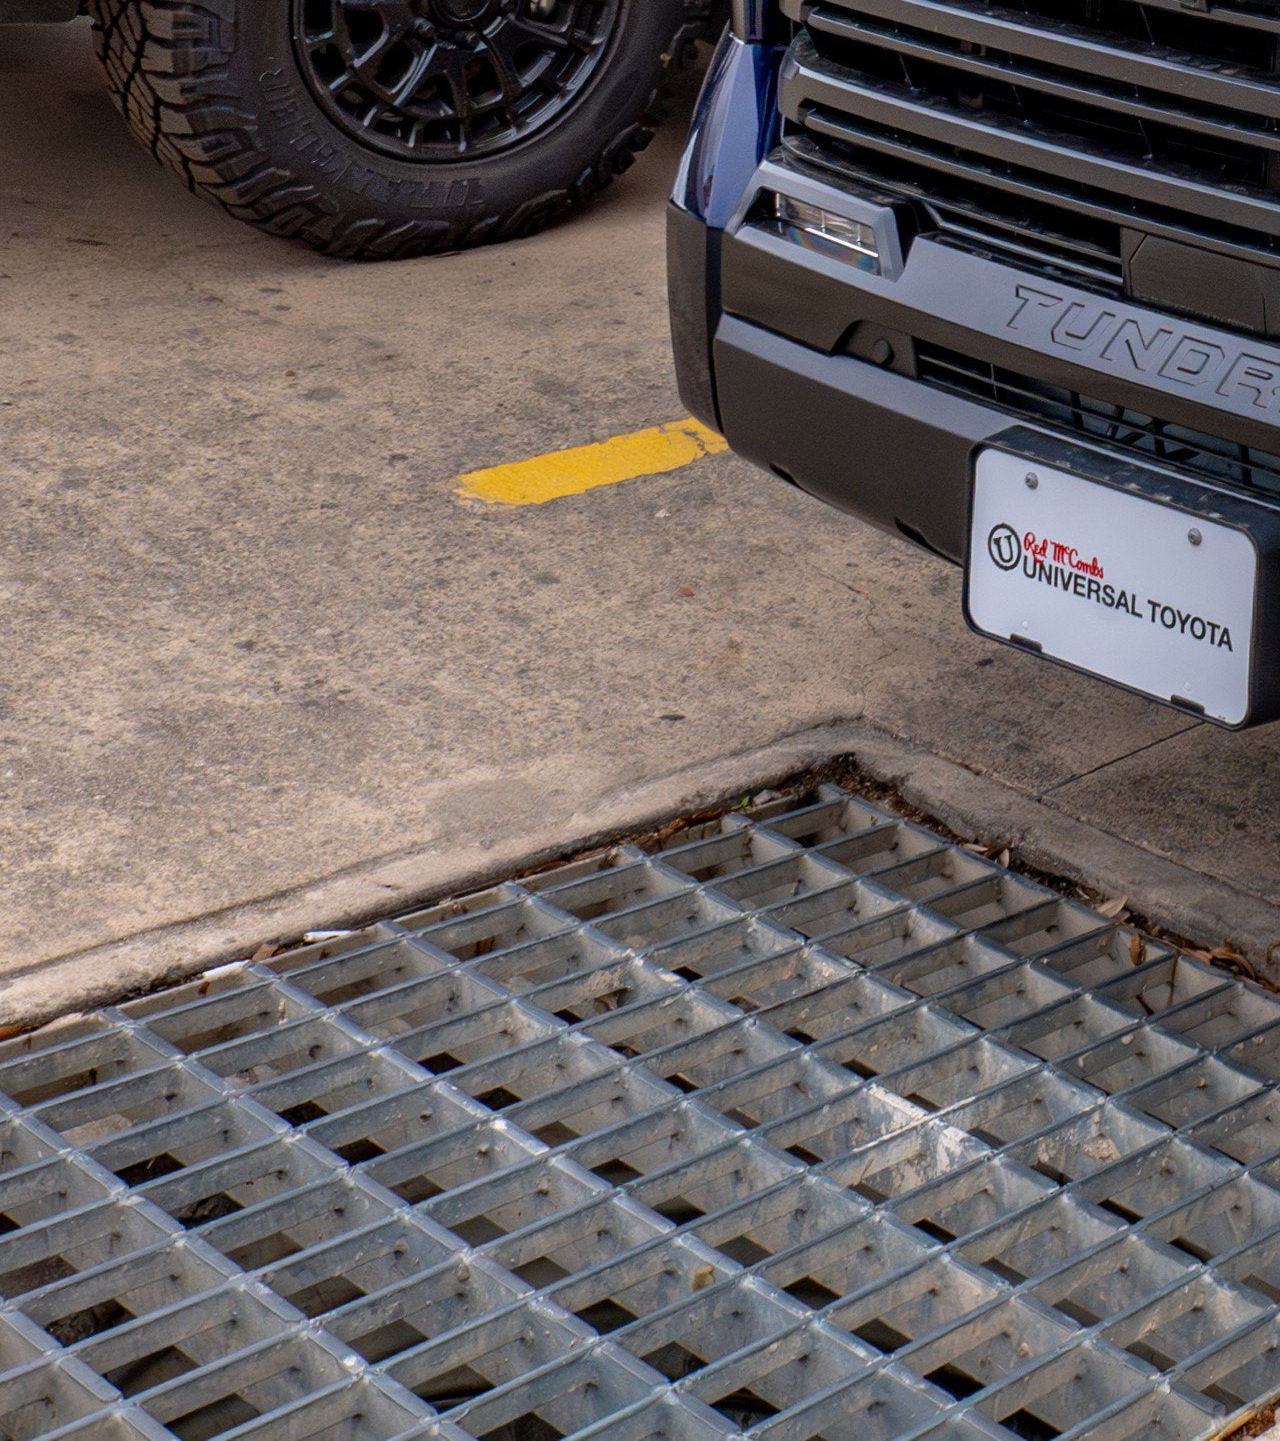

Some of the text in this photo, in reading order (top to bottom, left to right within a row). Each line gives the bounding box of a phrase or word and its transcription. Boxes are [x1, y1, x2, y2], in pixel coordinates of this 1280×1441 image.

[1023, 531, 1104, 579] Red McCombs
[1023, 554, 1234, 652] UNIVERSAL TOYOTA
